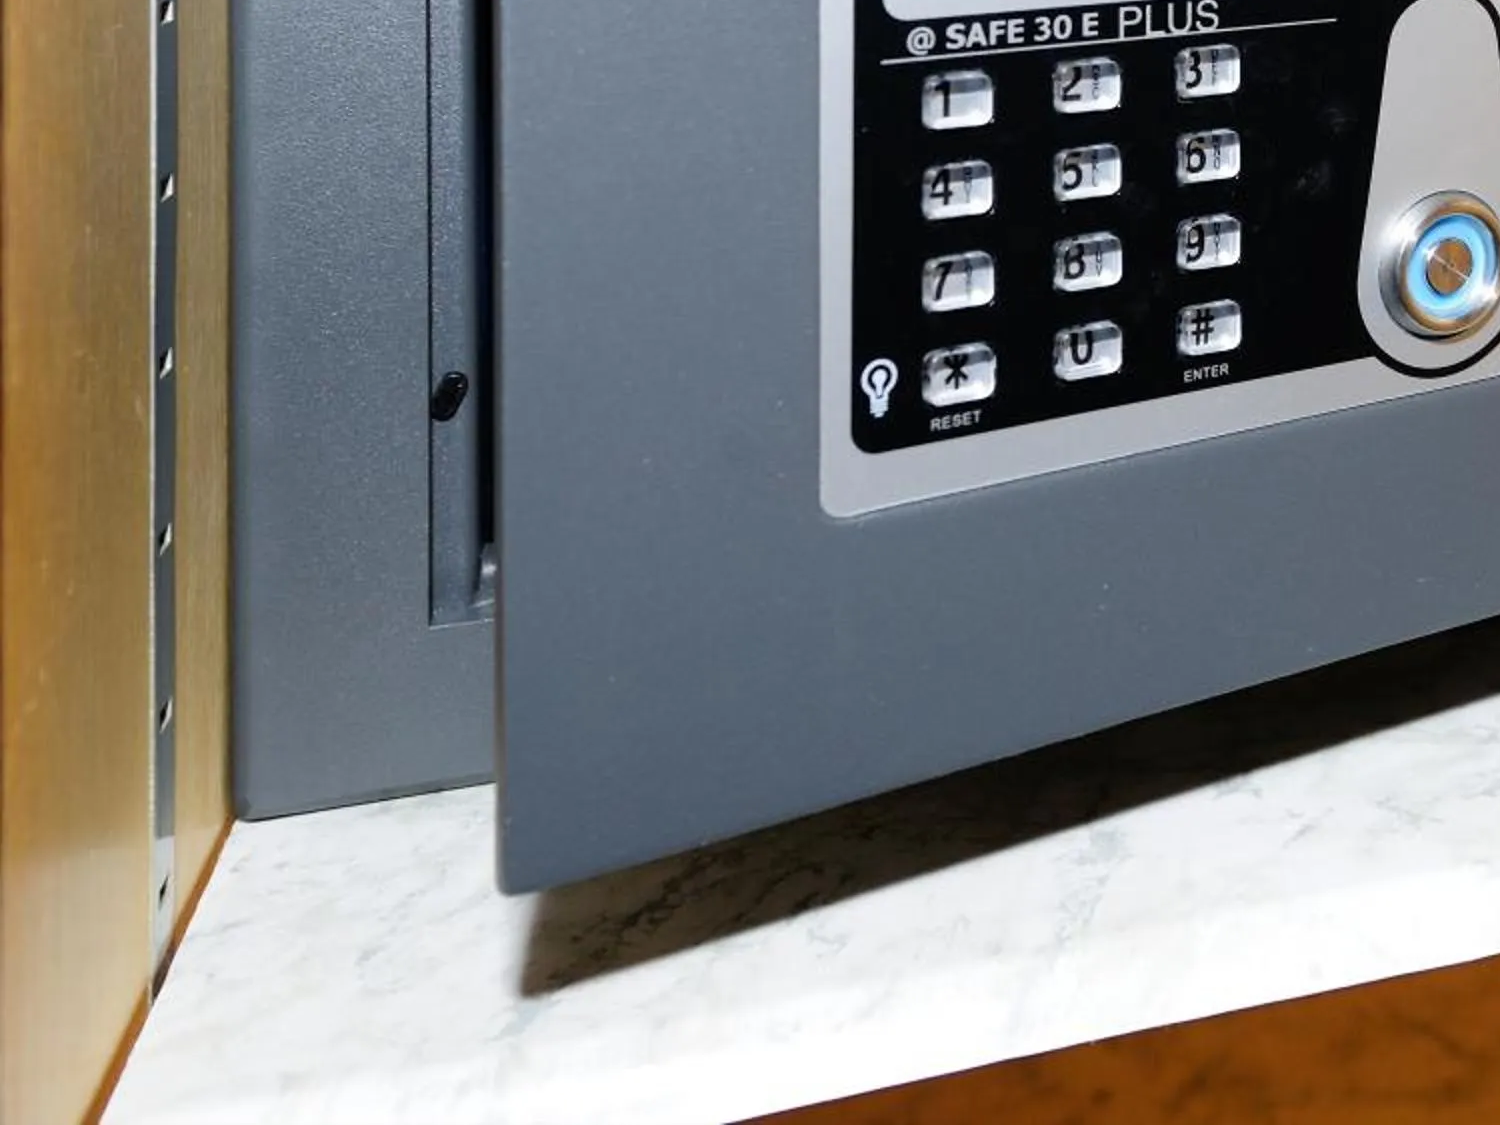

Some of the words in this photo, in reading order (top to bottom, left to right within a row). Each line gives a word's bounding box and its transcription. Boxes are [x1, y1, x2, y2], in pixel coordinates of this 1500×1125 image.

[945, 19, 1025, 50] SAFE
[1034, 15, 1072, 41] 30
[1081, 13, 1099, 38] E
[1118, 0, 1220, 40] PLUS
[1061, 66, 1082, 102] 2
[1185, 50, 1203, 89] 3
[934, 80, 952, 118] 1
[1062, 152, 1083, 191] 5
[1186, 137, 1206, 173] 6
[930, 168, 953, 206] 4
[1186, 222, 1205, 264] 9
[934, 261, 951, 302] 7
[1183, 363, 1230, 383] ENTER
[930, 409, 982, 432] RESET
